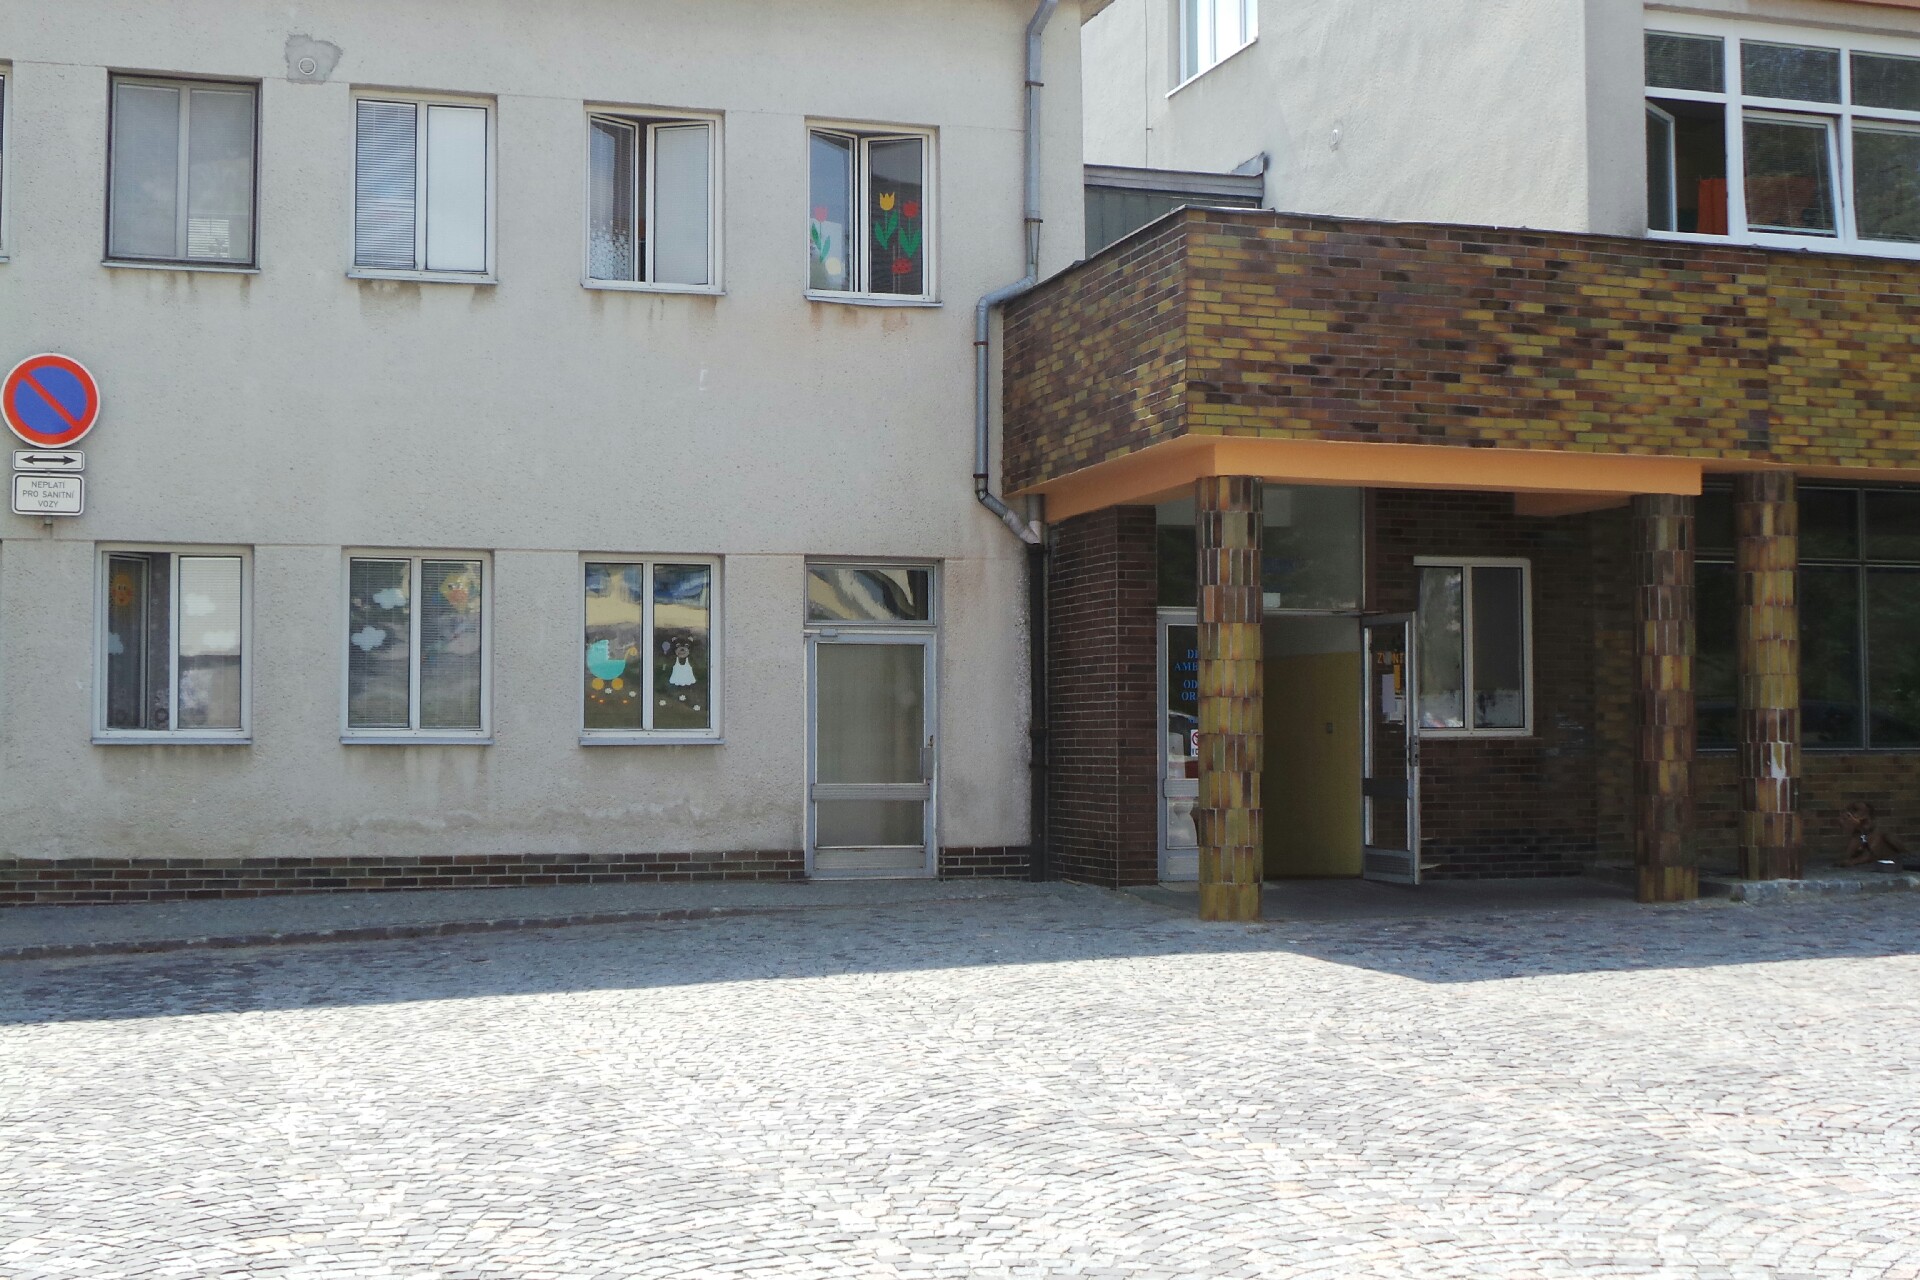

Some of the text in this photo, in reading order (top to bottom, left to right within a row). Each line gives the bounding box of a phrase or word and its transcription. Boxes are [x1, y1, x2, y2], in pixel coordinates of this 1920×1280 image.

[22, 489, 75, 499] PRO SANITNÍ
[37, 500, 59, 508] VOZY
[1174, 662, 1199, 672] AMB
[1183, 679, 1199, 689] OD
[1181, 691, 1198, 701] OR
